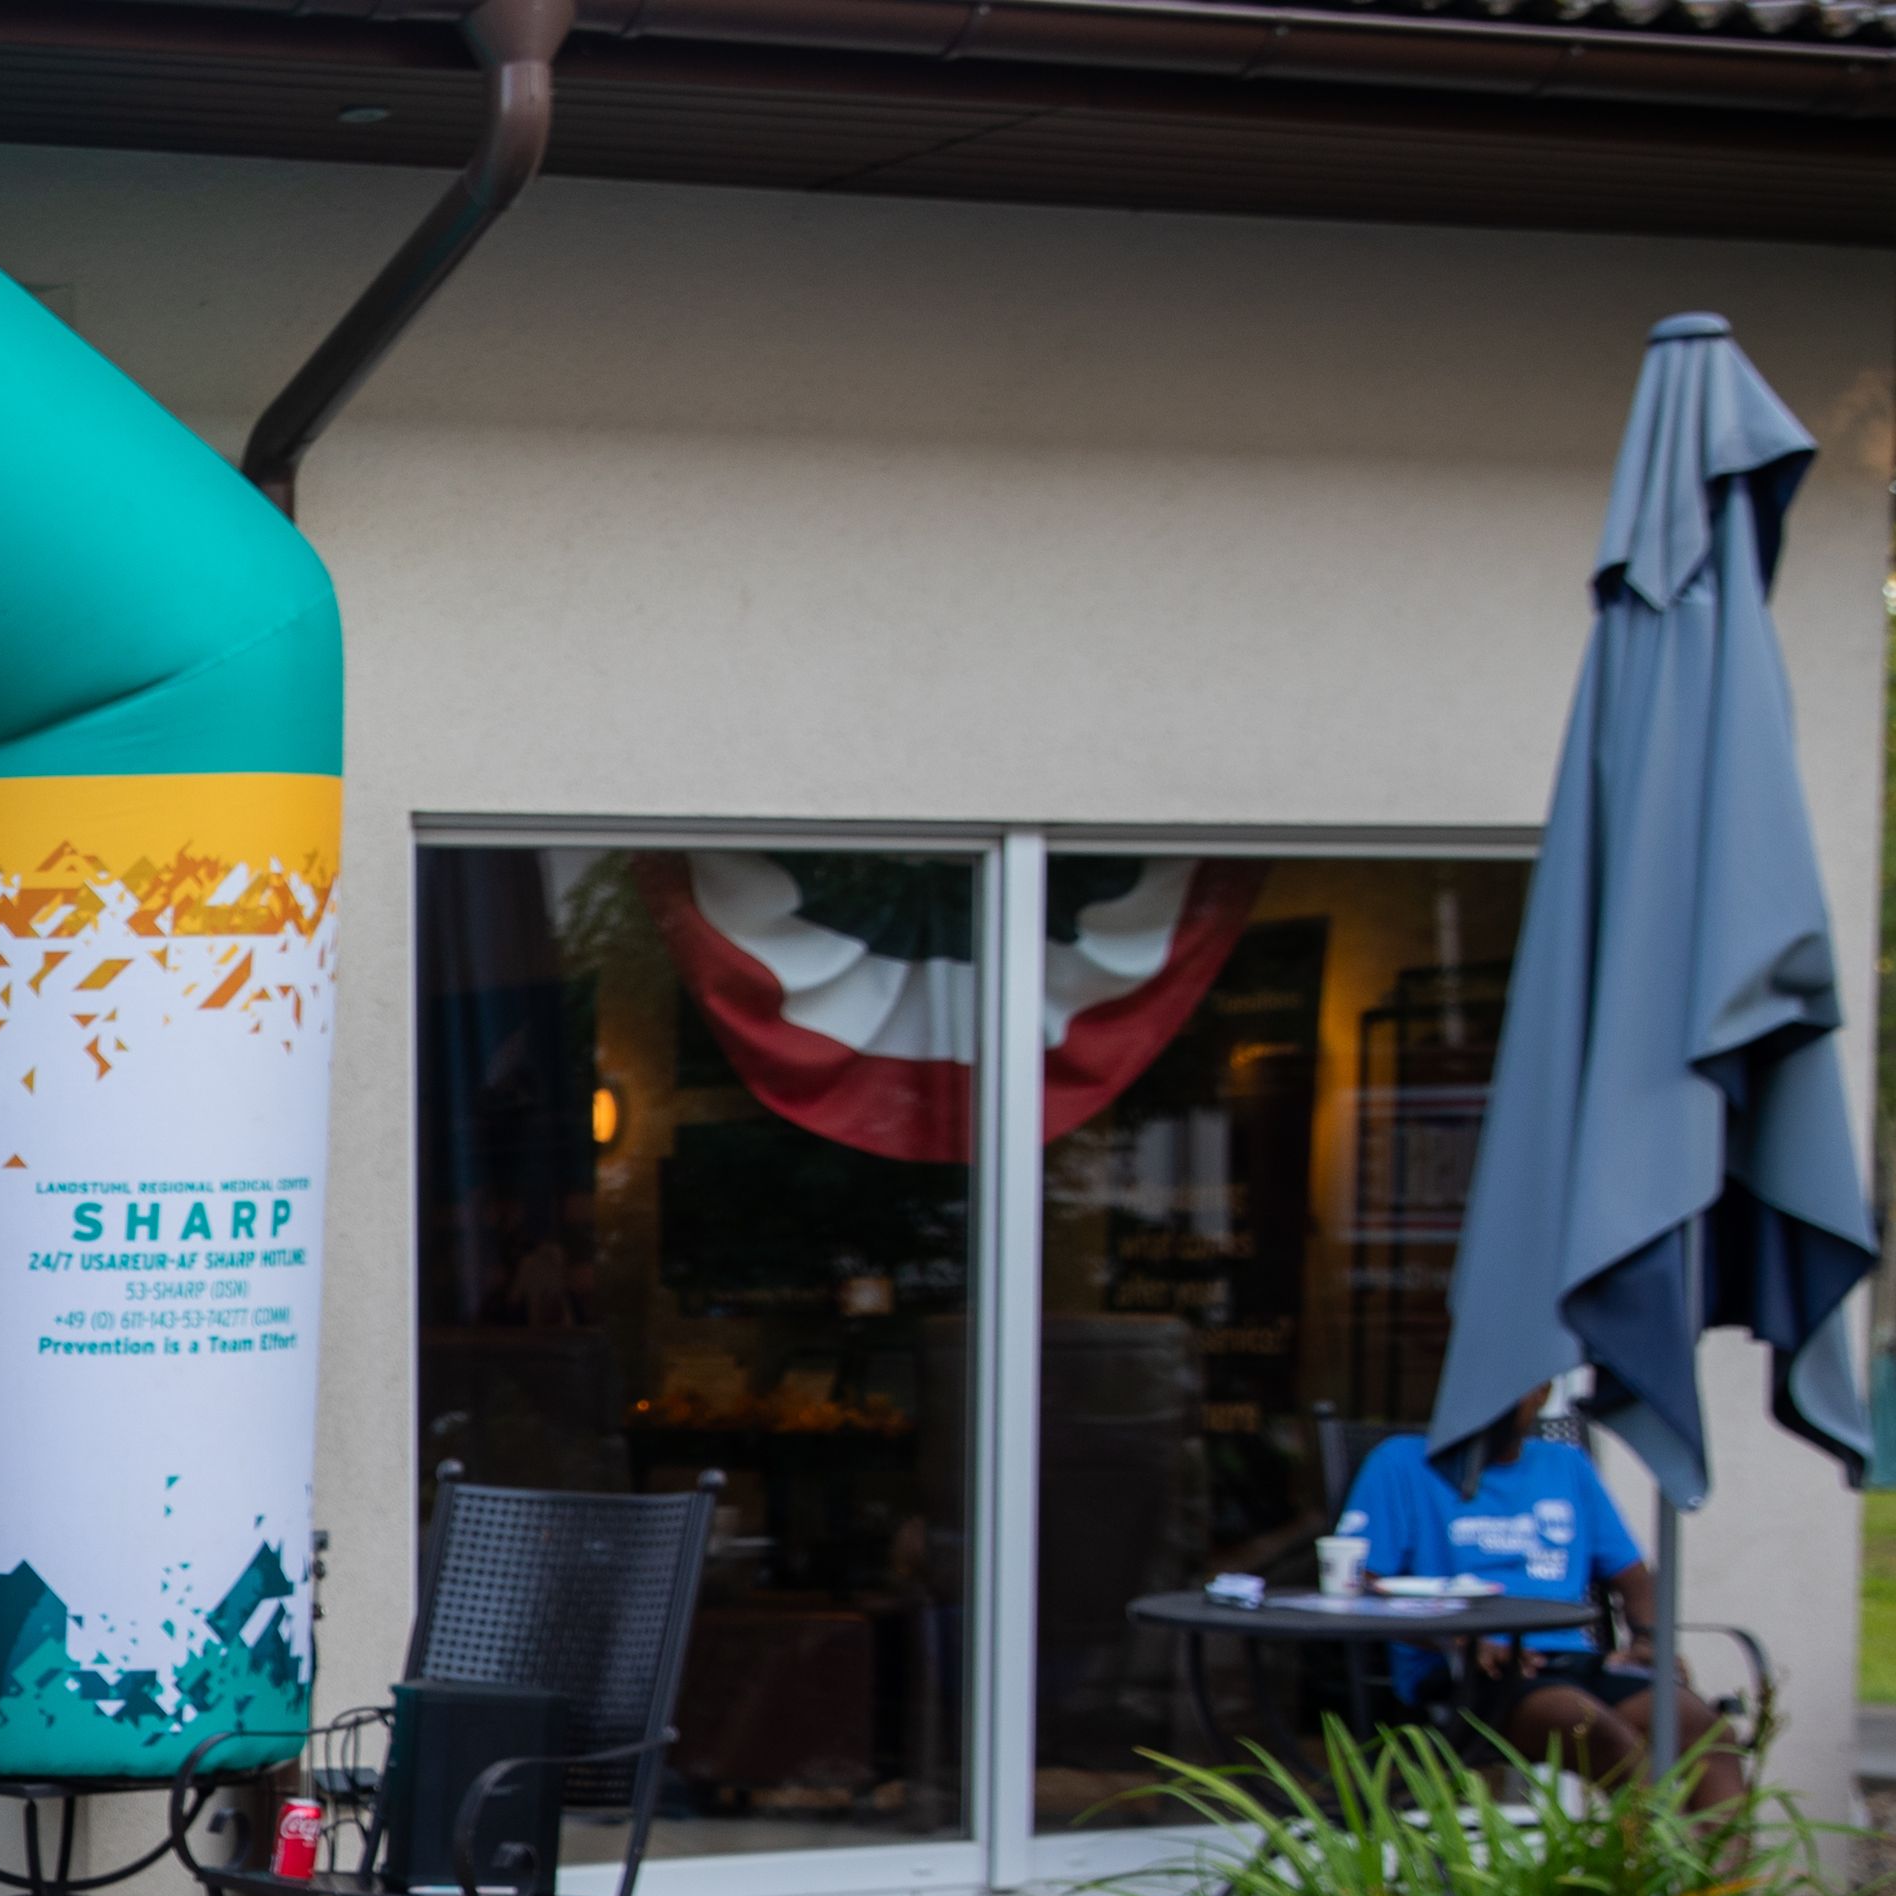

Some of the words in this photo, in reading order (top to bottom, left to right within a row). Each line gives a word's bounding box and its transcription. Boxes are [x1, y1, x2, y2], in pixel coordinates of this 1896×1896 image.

[35, 1181, 131, 1196] LANDSTUHL
[138, 1180, 214, 1194] REGIONAL
[220, 1178, 273, 1193] MEDICAL
[70, 1198, 292, 1242] SHARP
[28, 1251, 74, 1273] 24/7
[80, 1251, 199, 1272] USAREUR-AF
[204, 1249, 256, 1270] SHARP
[125, 1280, 207, 1301] 53-SHARP
[210, 1279, 250, 1300] (DSN)
[52, 1310, 85, 1330] +49
[38, 1335, 156, 1356] Prevention
[164, 1336, 180, 1355] is
[188, 1340, 200, 1354] a
[208, 1334, 253, 1353] Team
[259, 1332, 298, 1350] Effort
